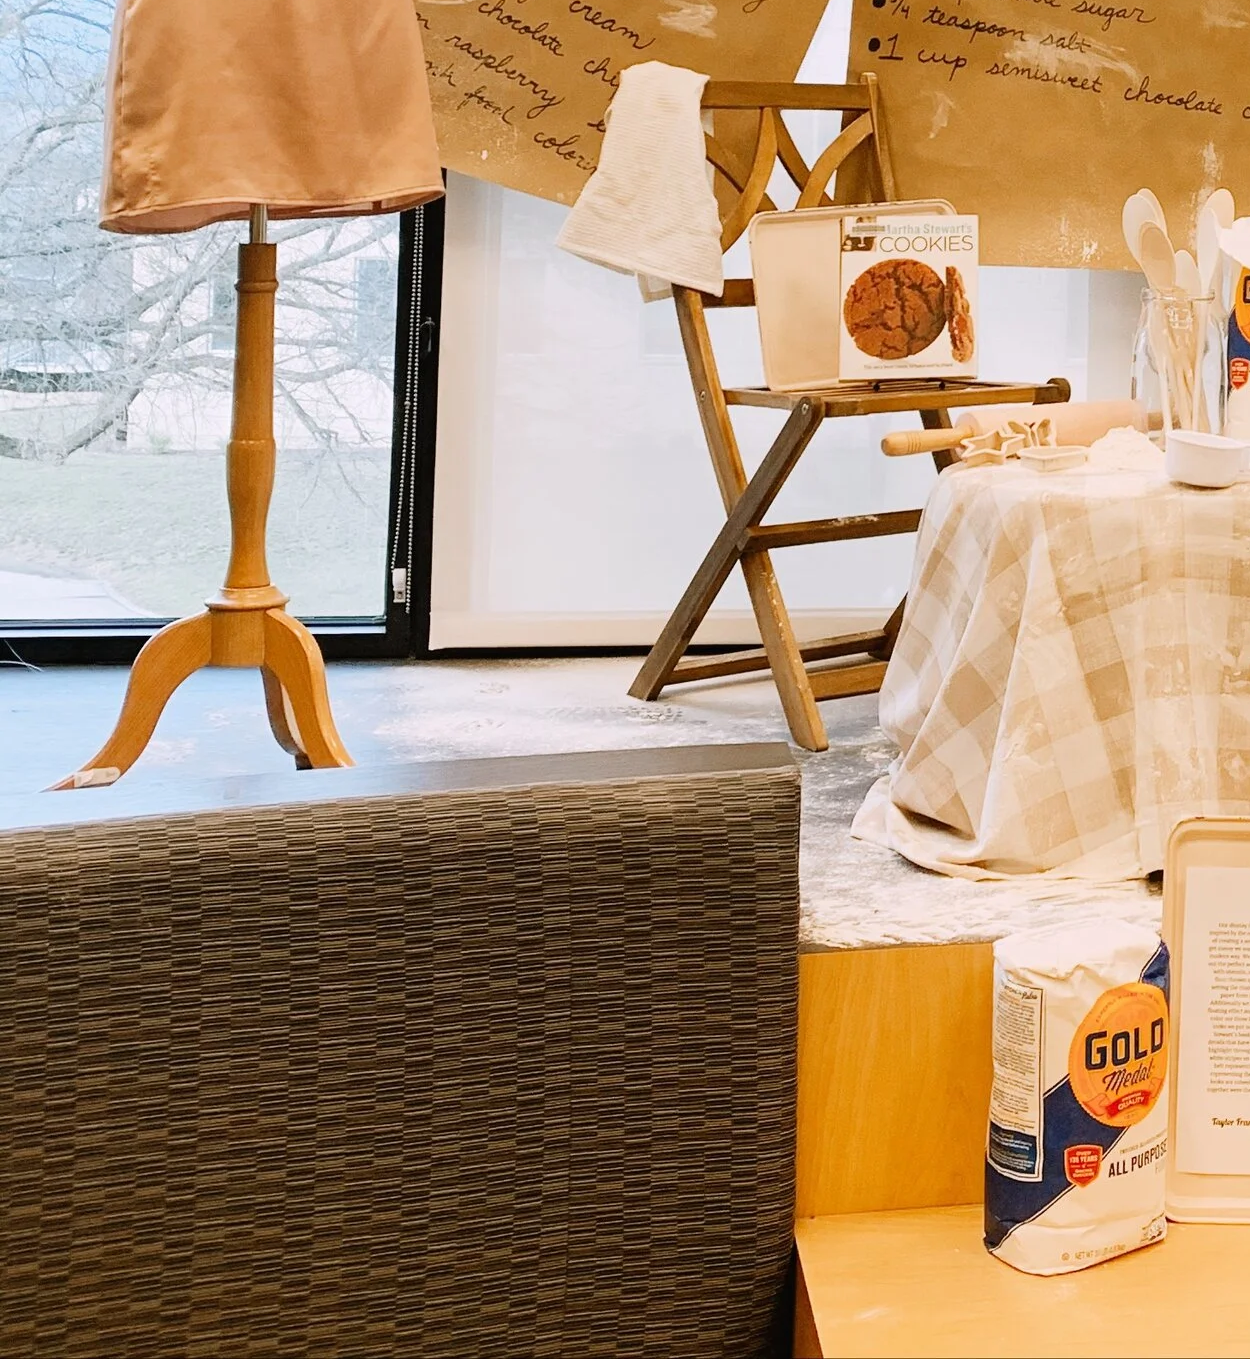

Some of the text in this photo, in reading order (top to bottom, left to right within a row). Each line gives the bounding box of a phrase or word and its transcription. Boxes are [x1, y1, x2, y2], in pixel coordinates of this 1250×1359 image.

[569, 0, 656, 50] cream
[923, 4, 1028, 44] teaspoon
[1039, 32, 1092, 55] salt
[445, 34, 565, 120] raspberry
[879, 33, 904, 61] 1
[917, 51, 968, 80] cup
[985, 58, 1104, 94] semisweet
[1124, 77, 1224, 116] chocolate
[533, 131, 598, 175] colorin
[880, 235, 974, 252] COOKIES
[924, 224, 972, 234] Stewart's
[1085, 1017, 1164, 1071] GOLD
[1103, 1058, 1155, 1095] Medal
[1118, 1095, 1145, 1111] QUALITY
[1108, 1162, 1128, 1178] ALL
